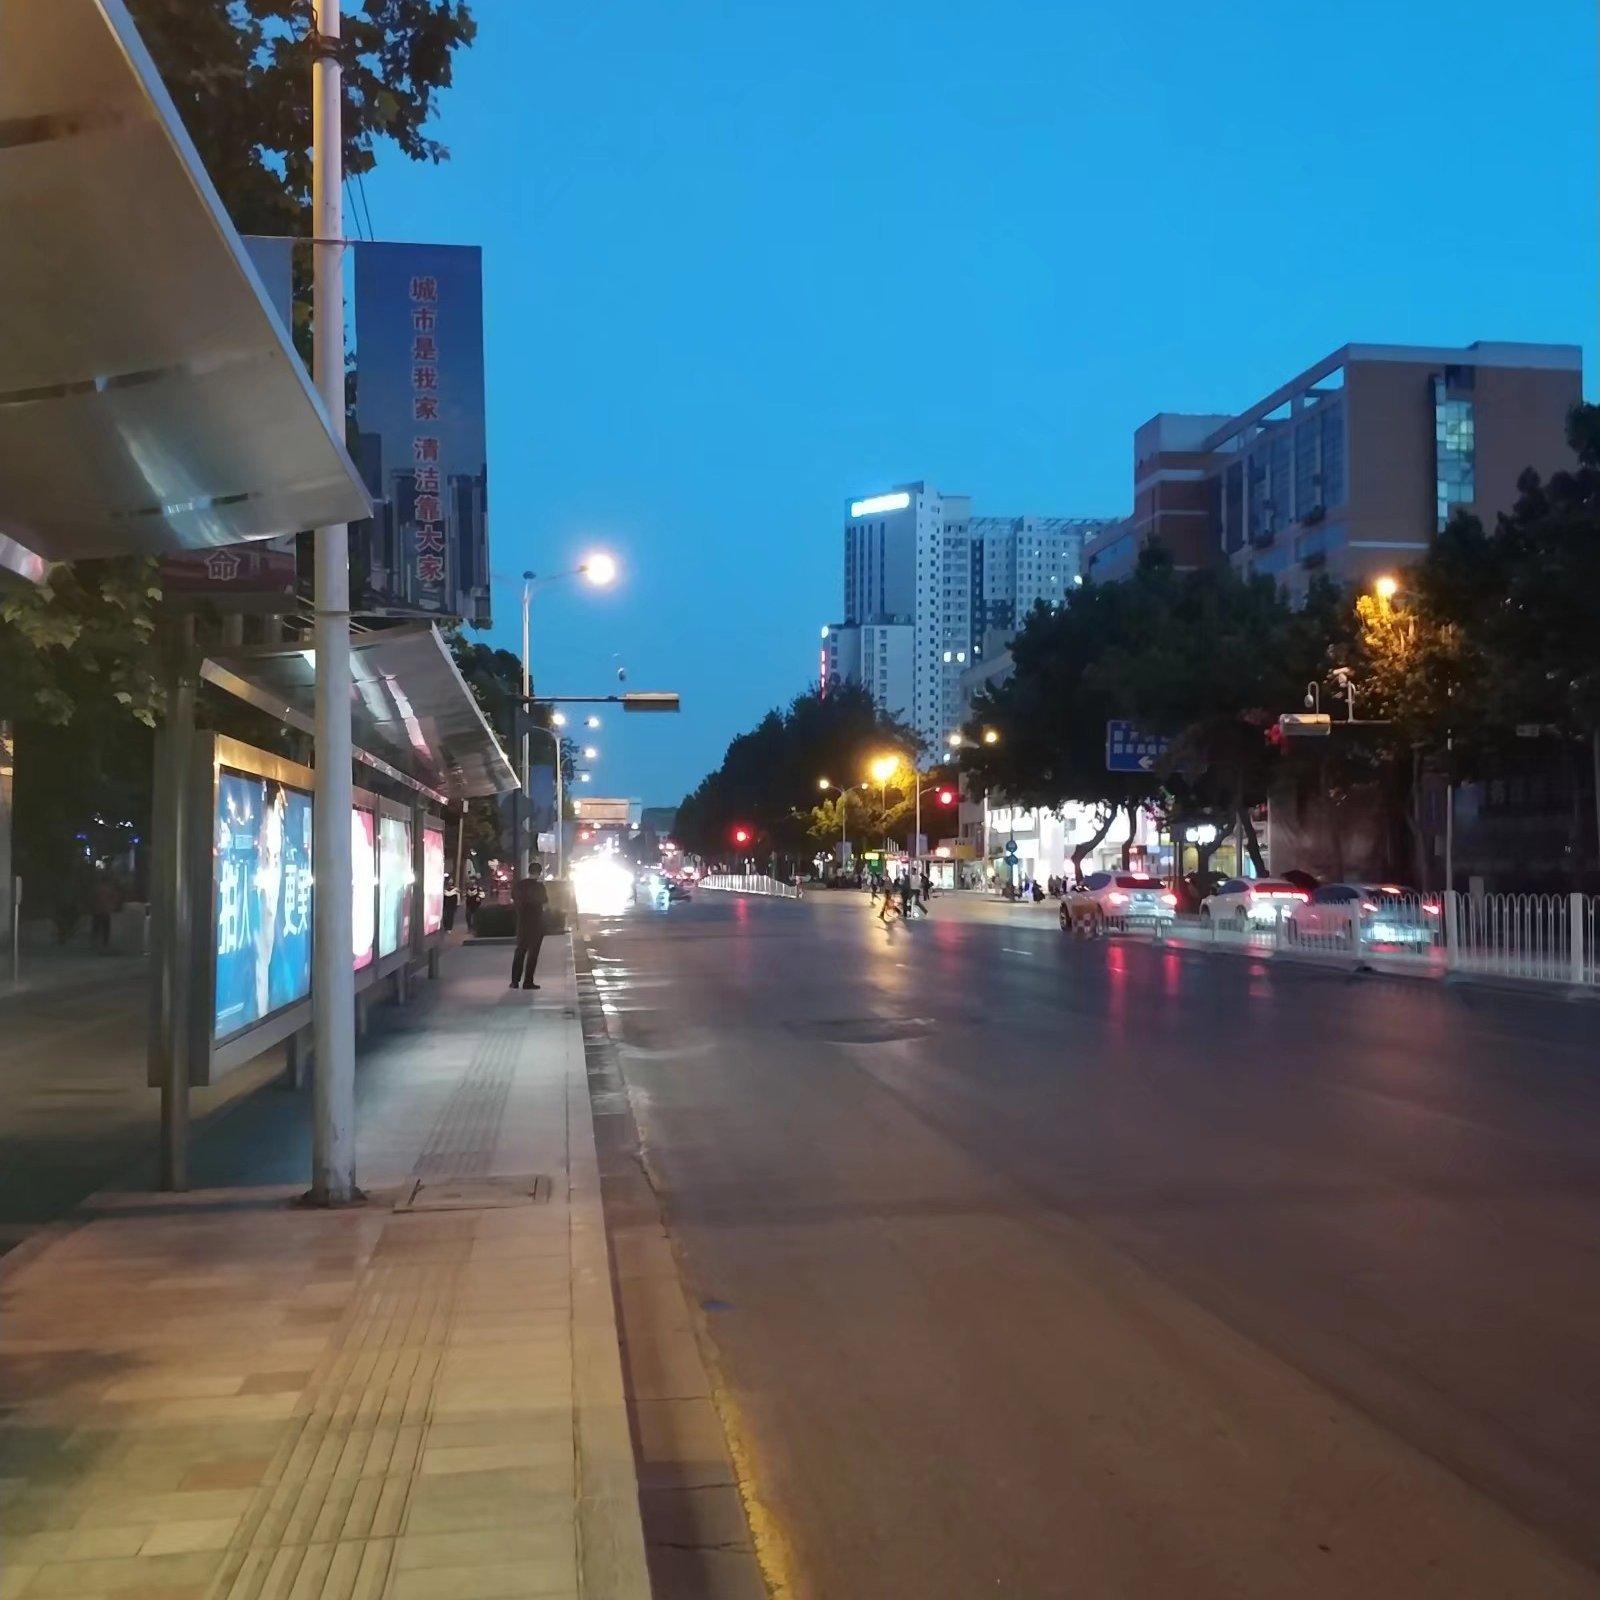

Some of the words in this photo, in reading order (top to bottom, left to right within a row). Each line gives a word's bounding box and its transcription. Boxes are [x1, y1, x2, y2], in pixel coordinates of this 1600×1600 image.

[409, 276, 438, 421] 城市是我家
[205, 548, 241, 582] 命
[413, 437, 445, 581] 清洁靠大家
